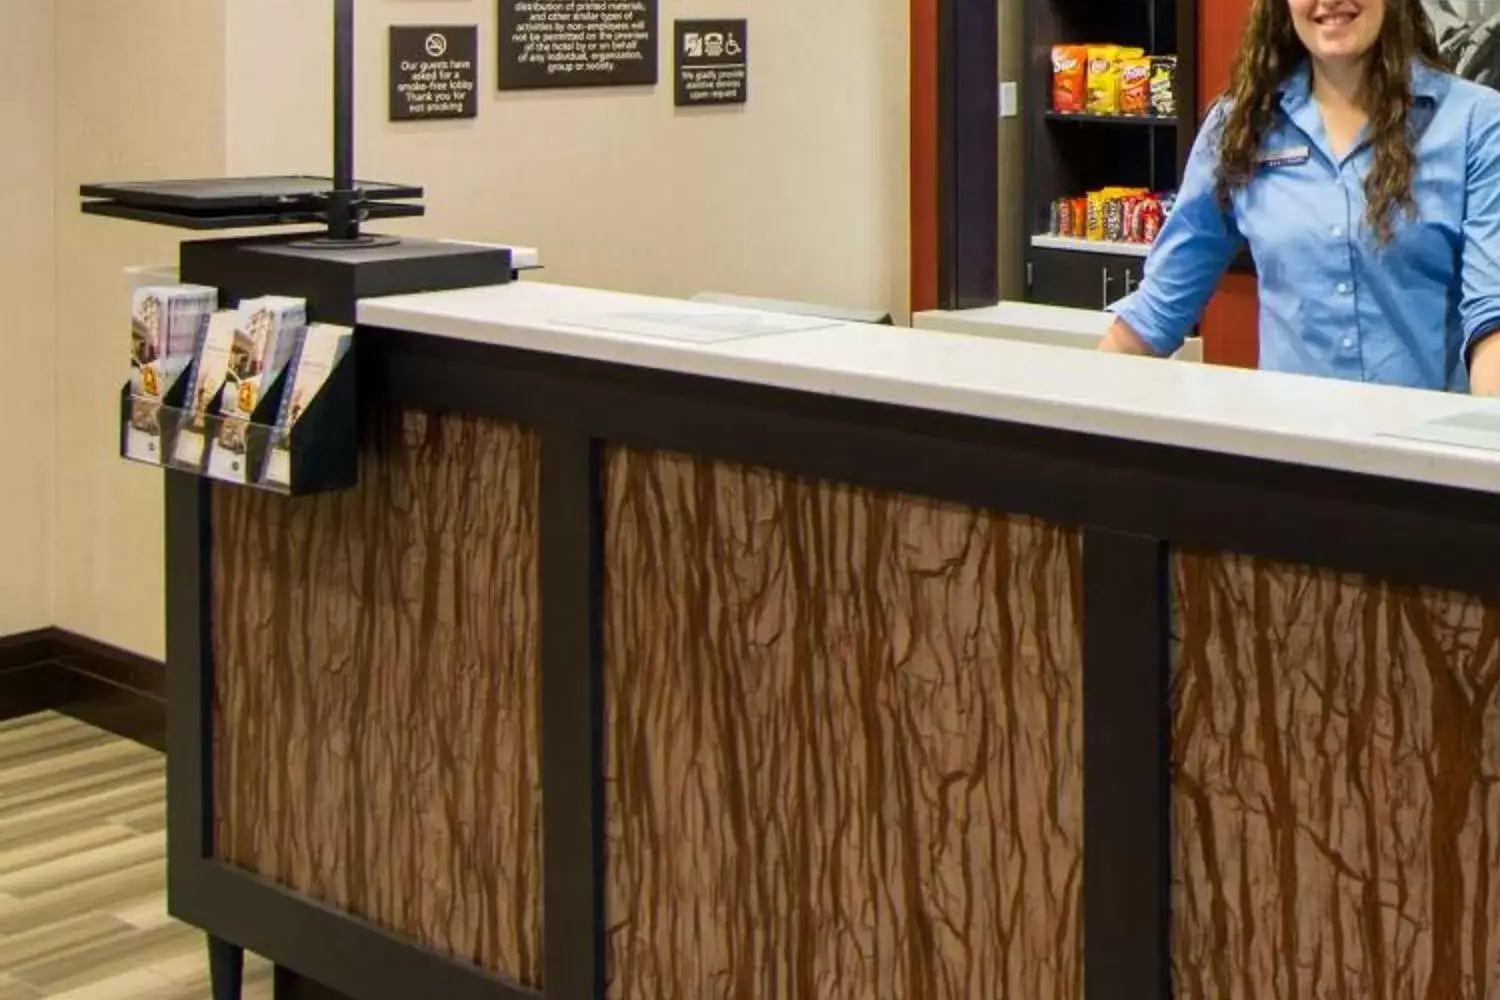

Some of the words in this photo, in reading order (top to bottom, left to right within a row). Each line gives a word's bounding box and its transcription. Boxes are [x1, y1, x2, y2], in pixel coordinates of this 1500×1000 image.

[514, 2, 564, 12] distribution
[565, 2, 575, 11] of
[576, 2, 607, 12] printed
[529, 12, 546, 21] and
[547, 12, 571, 21] other
[572, 11, 599, 21] similar
[600, 12, 622, 23] types
[623, 12, 633, 21] of
[516, 22, 553, 32] activities
[554, 22, 565, 33] by
[631, 21, 645, 30] will
[511, 32, 528, 42] not
[529, 32, 541, 41] be
[542, 32, 585, 43] permitted
[599, 32, 613, 41] the
[614, 32, 649, 43] premises
[524, 41, 535, 52] of
[535, 41, 551, 51] the
[552, 41, 575, 51] hotel
[575, 41, 587, 53] by
[588, 43, 598, 51] or
[611, 40, 638, 50] behalf
[517, 51, 529, 63] of
[529, 53, 545, 63] any
[400, 61, 418, 71] Our
[419, 61, 449, 72] guests
[449, 60, 471, 69] have
[547, 63, 574, 74] group
[575, 64, 585, 72] or
[411, 71, 437, 81] asked
[438, 70, 453, 80] for
[453, 71, 460, 79] a
[397, 81, 448, 91] smoke-free
[449, 80, 473, 91] lobby
[405, 91, 433, 101] Thank
[434, 93, 451, 102] you
[453, 91, 466, 100] for
[409, 103, 425, 113] not
[426, 101, 463, 113] smoking
